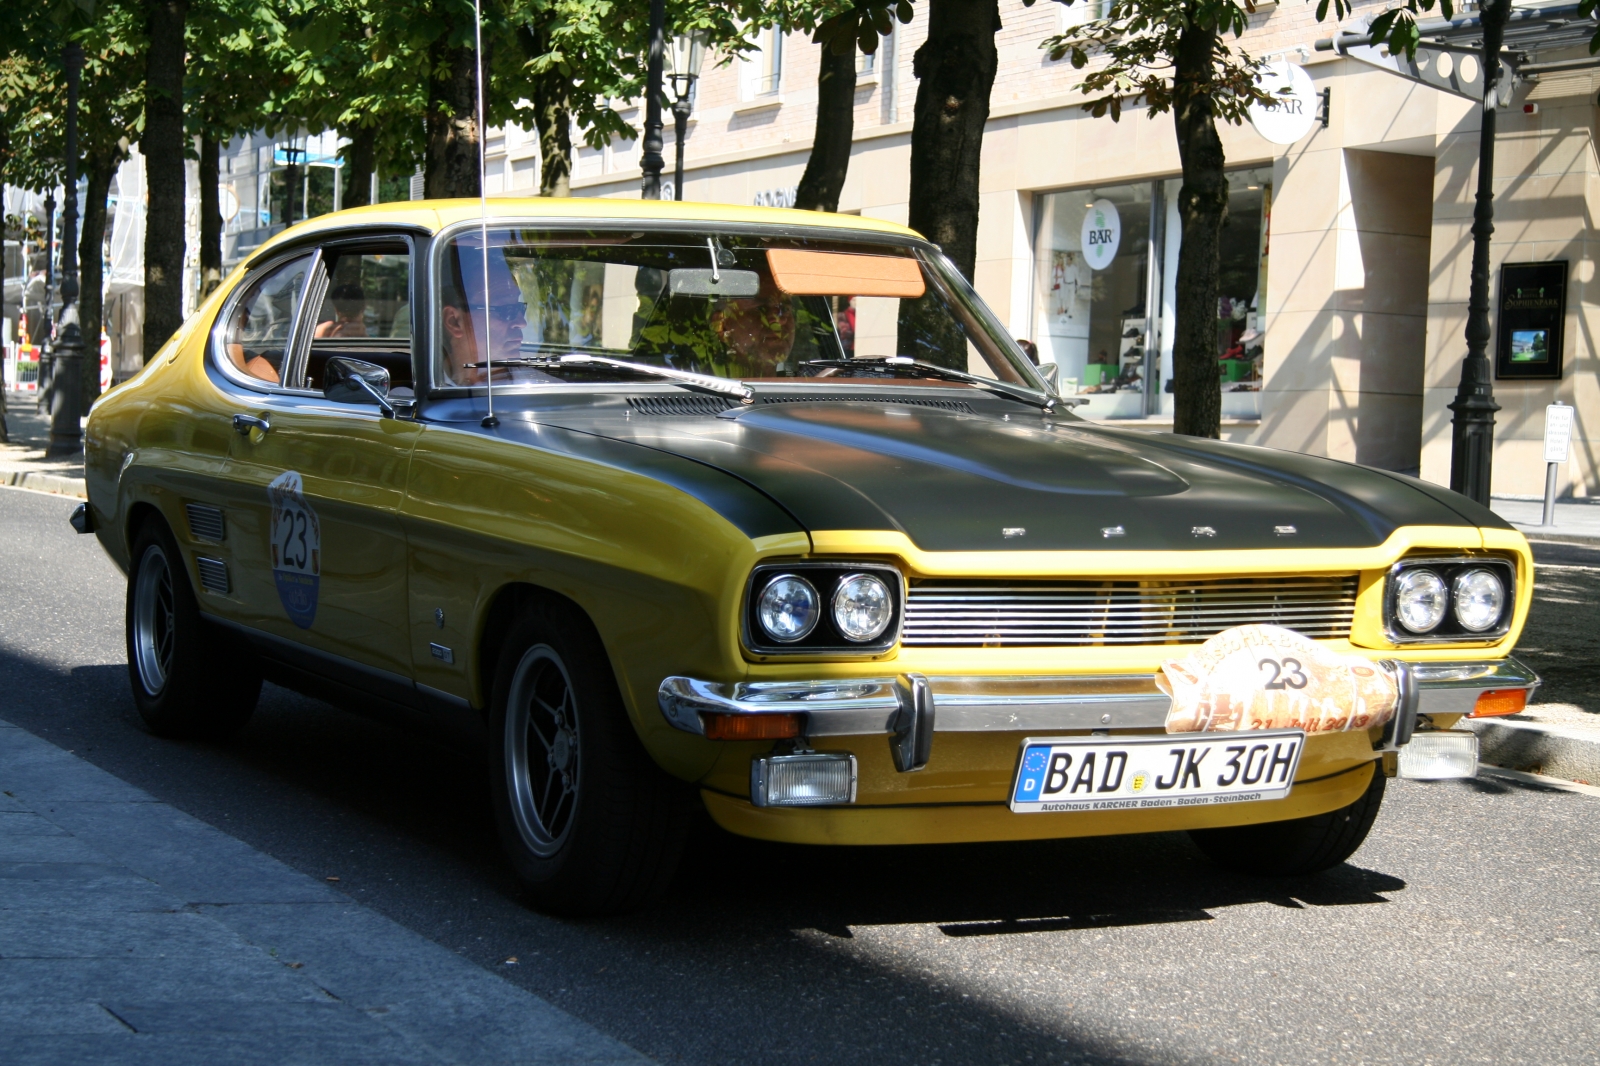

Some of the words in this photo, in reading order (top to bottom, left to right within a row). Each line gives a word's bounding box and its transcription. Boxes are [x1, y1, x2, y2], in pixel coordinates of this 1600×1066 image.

[1089, 229, 1112, 245] BÄR
[1474, 387, 1484, 395] 21
[283, 508, 307, 570] 23
[1258, 657, 1307, 690] 23
[1042, 751, 1128, 794] BAD
[1155, 747, 1211, 790] JK
[1217, 742, 1297, 787] 30H
[1024, 778, 1035, 791] D
[1041, 802, 1090, 811] Autohaus
